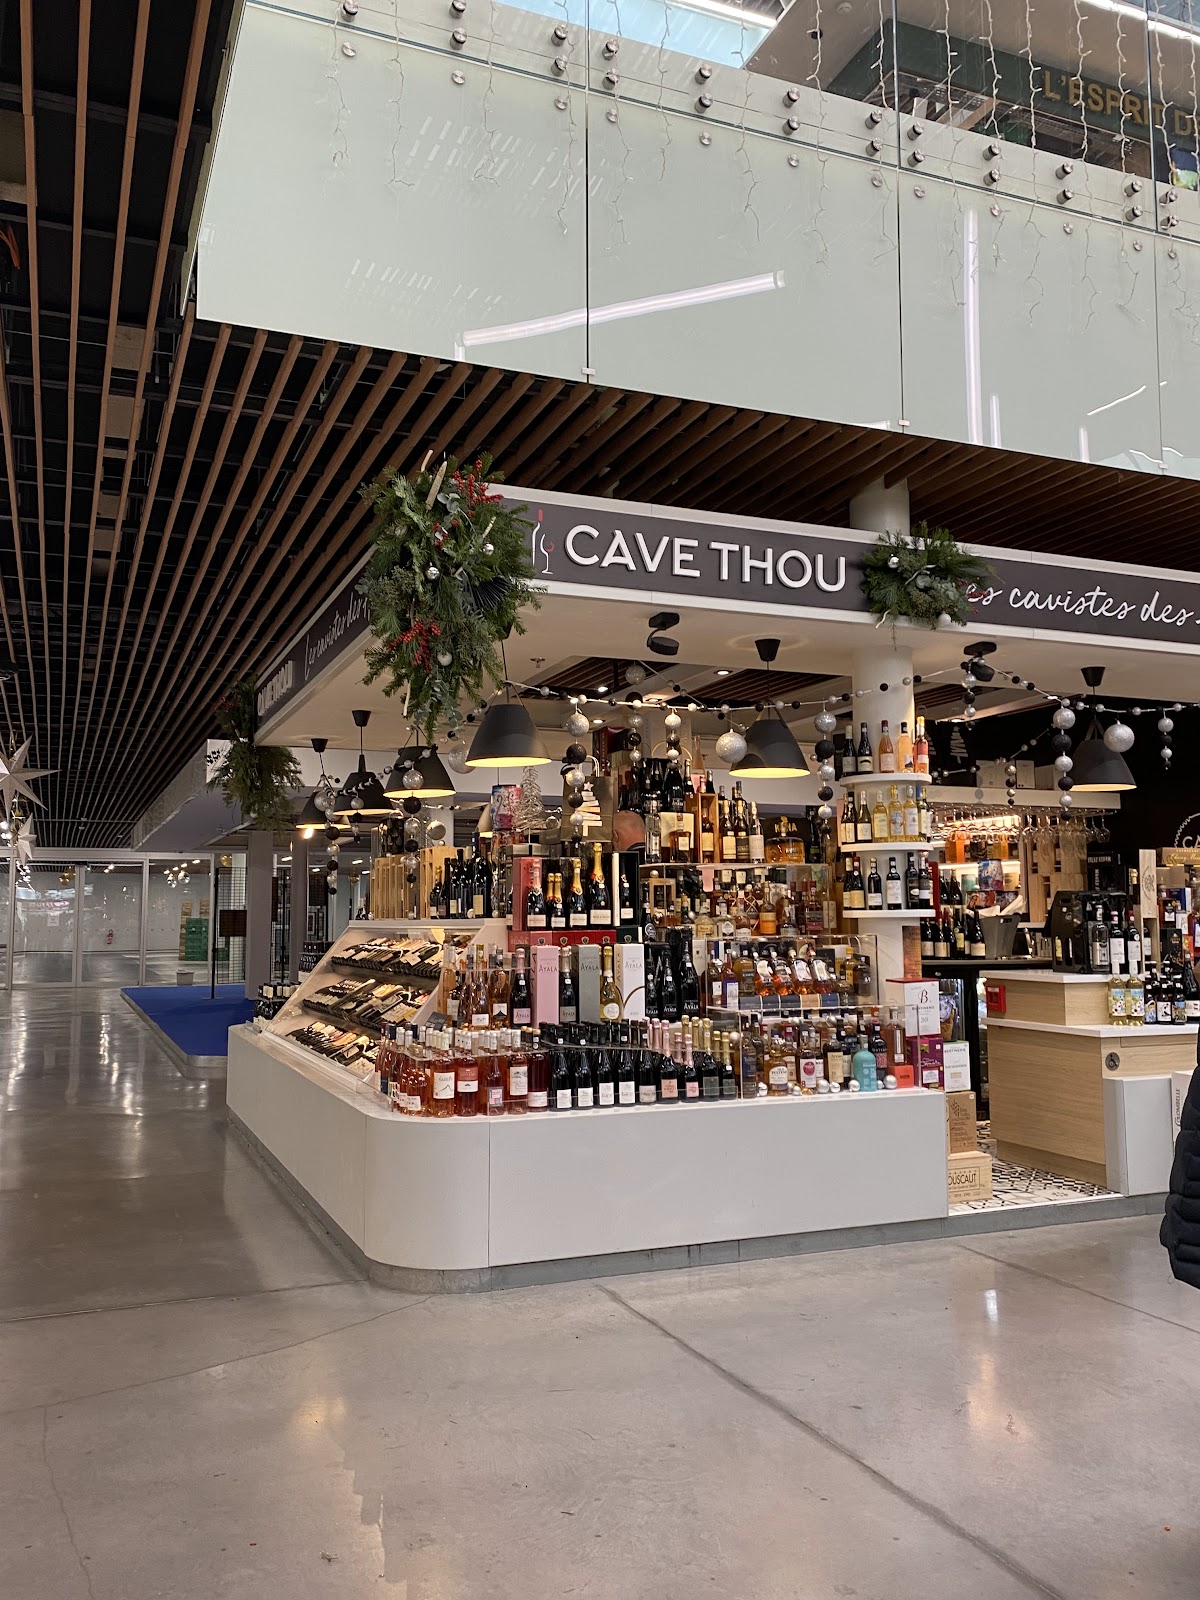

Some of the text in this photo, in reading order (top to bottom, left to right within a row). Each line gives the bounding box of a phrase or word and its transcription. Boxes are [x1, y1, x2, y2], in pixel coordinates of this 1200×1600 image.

[1042, 70, 1163, 126] L'ESPRIT
[564, 524, 847, 593] CAVE THOU
[965, 582, 1194, 627] es cavistes des
[538, 963, 558, 973] AYALA
[580, 962, 600, 972] AYALA
[624, 960, 643, 970] AYALA
[948, 1173, 977, 1186] OUSCAUT
